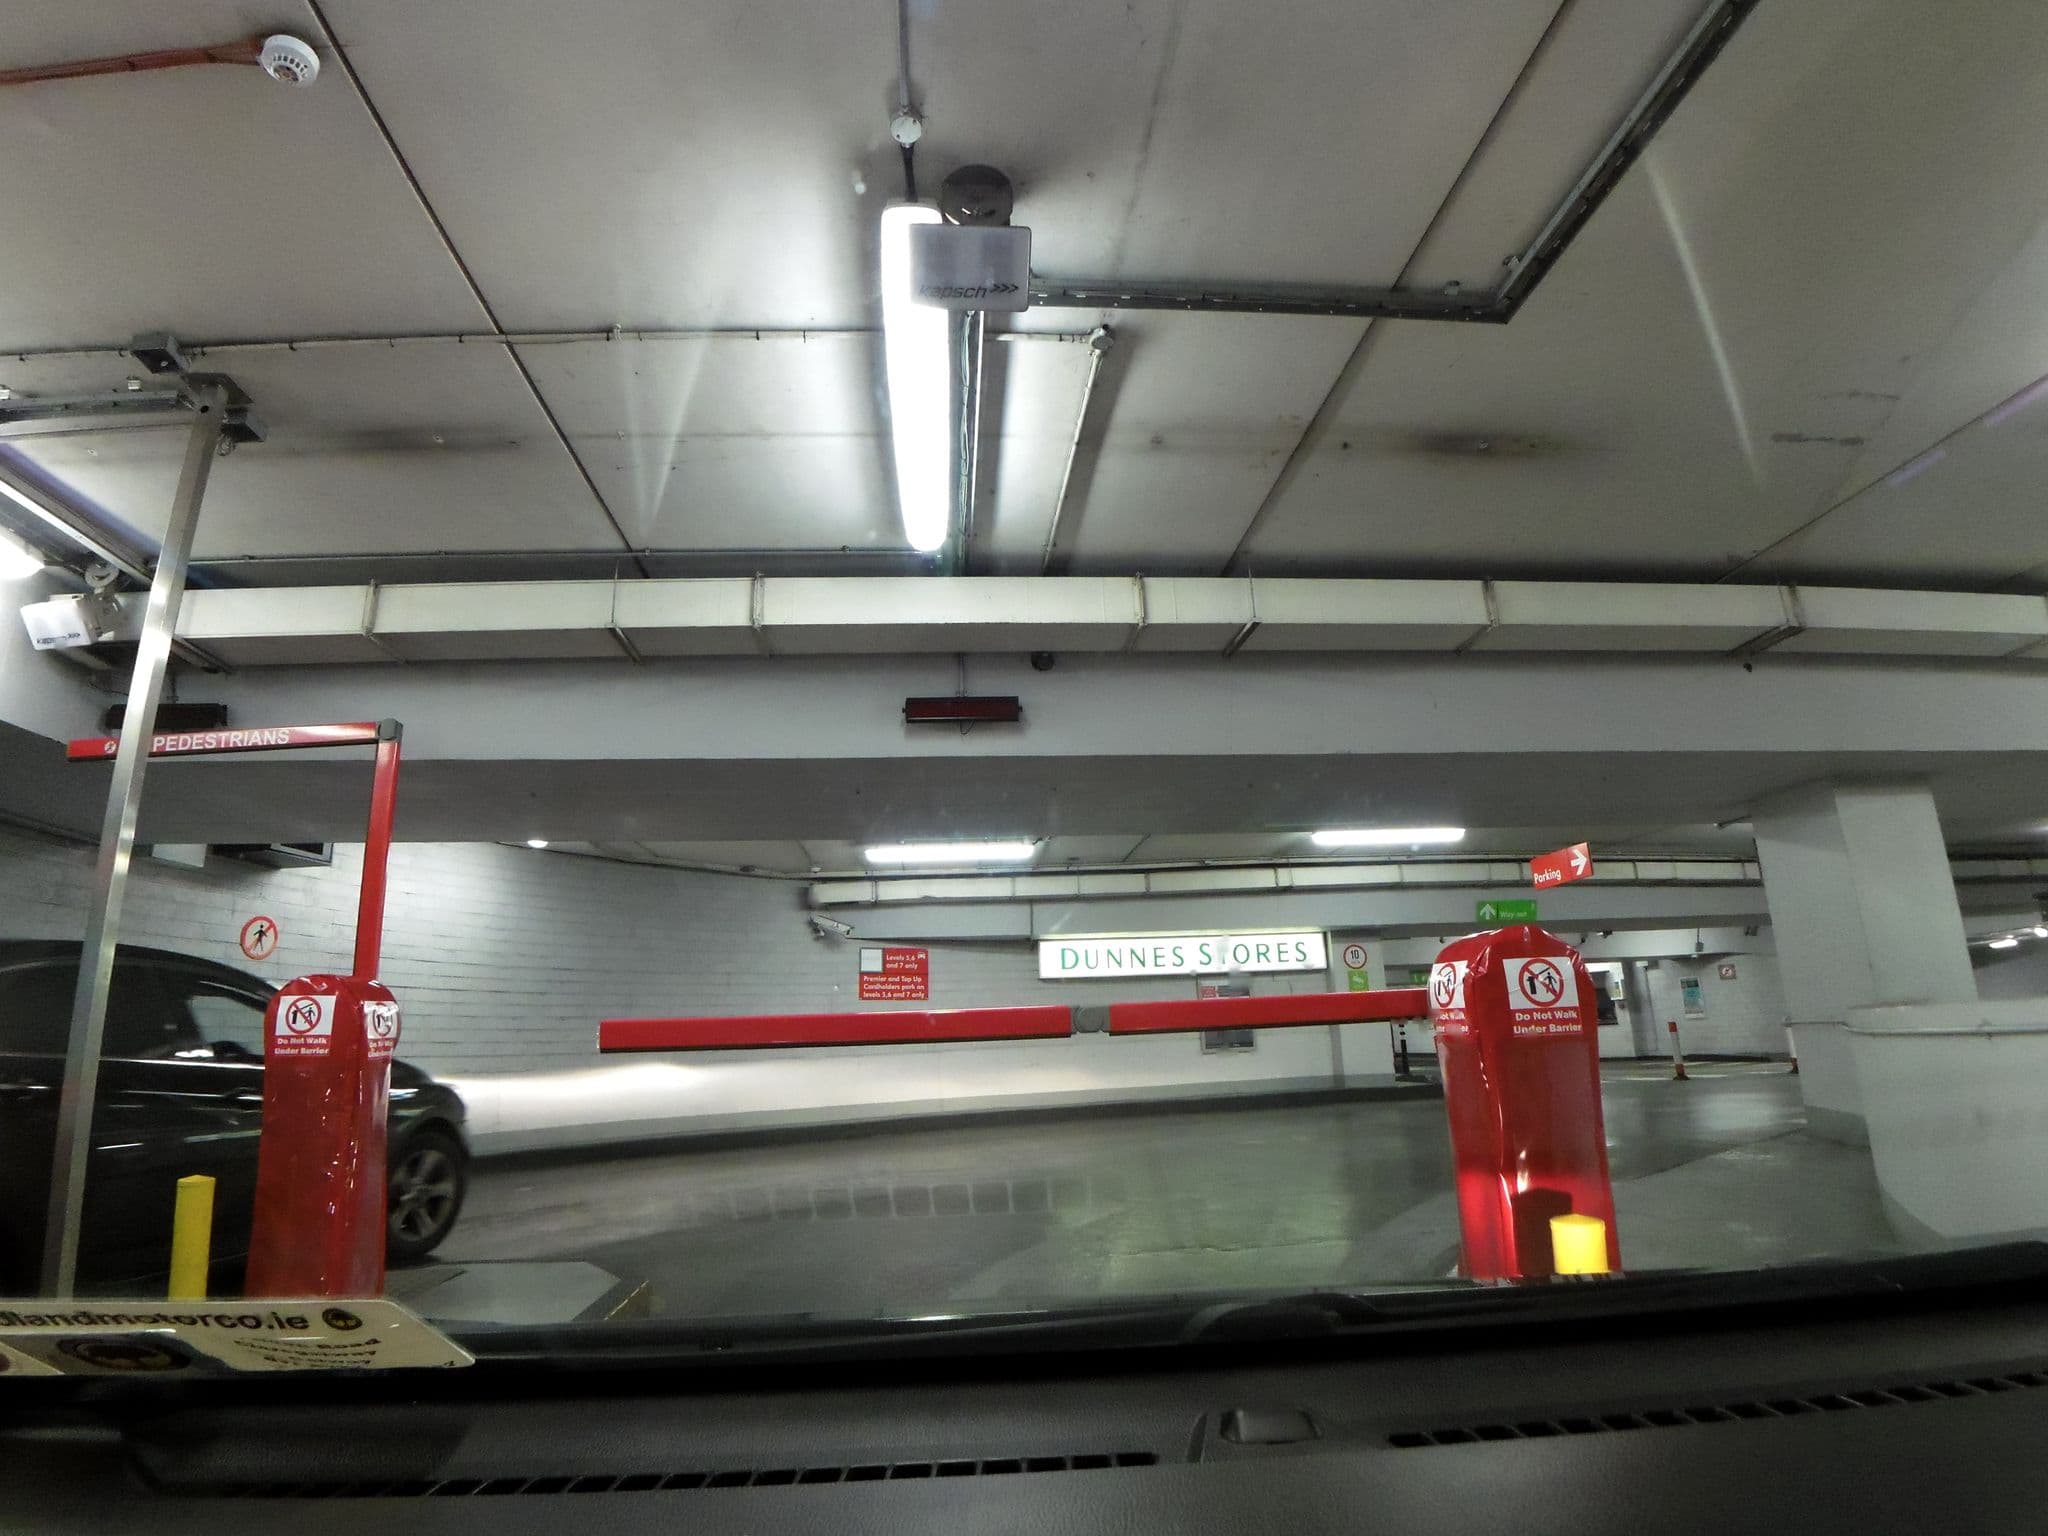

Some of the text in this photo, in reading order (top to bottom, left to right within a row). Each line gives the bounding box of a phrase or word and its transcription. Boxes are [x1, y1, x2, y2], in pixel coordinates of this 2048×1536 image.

[153, 730, 290, 752] PEDESTRIANS
[1533, 868, 1562, 884] Parking
[1060, 945, 1185, 970] DUNNES
[1350, 949, 1360, 960] 10
[904, 962, 918, 970] only
[912, 975, 922, 983] Up
[901, 983, 915, 991] park
[911, 991, 925, 999] only
[1515, 1010, 1577, 1021] Do Not Walk
[1513, 1023, 1582, 1034] Under Barrier
[274, 1047, 329, 1055] Under Barrier
